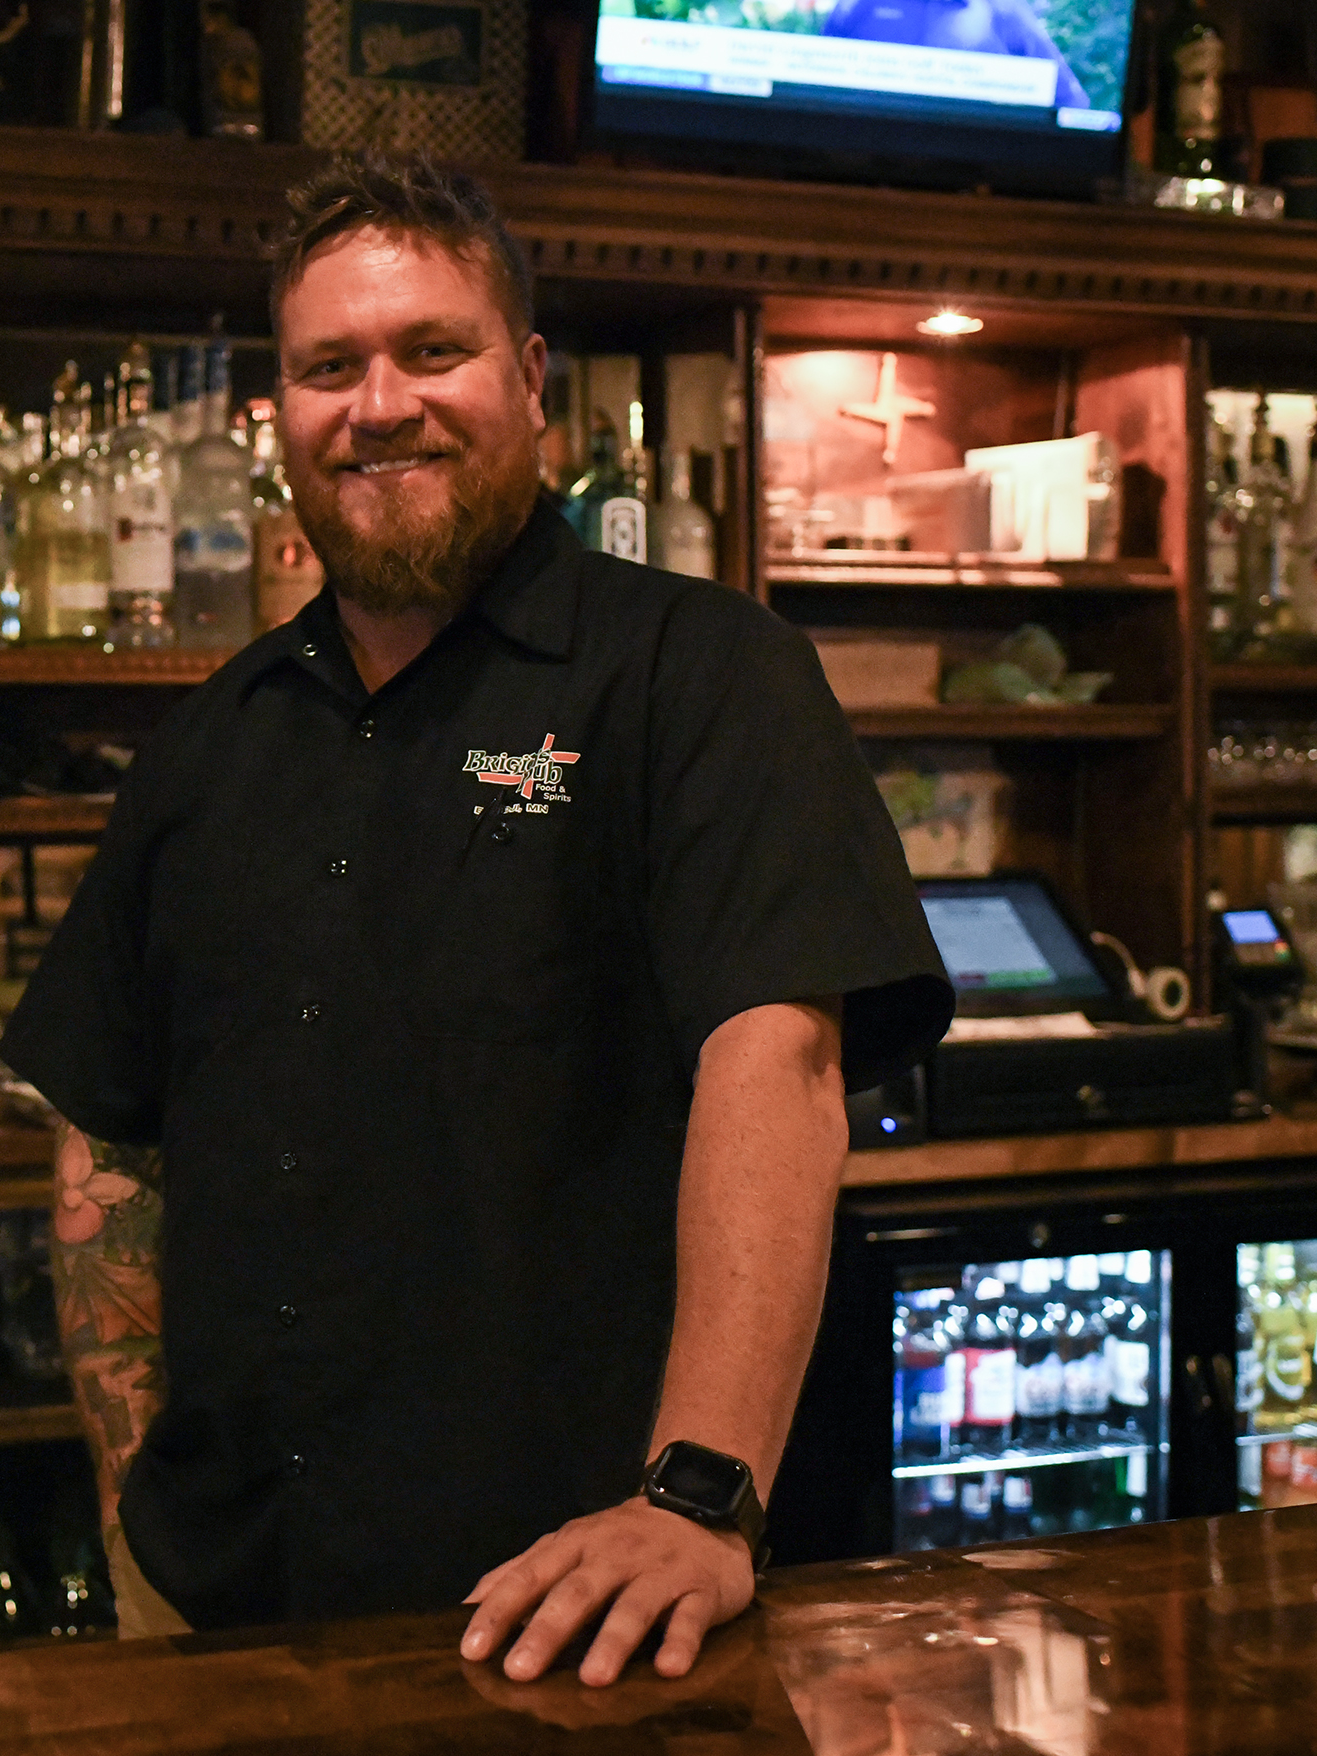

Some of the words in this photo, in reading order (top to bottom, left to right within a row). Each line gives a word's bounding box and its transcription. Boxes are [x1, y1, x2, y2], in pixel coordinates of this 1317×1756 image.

[535, 783, 557, 792] Food
[543, 792, 572, 803] Spirits
[525, 803, 549, 814] MN
